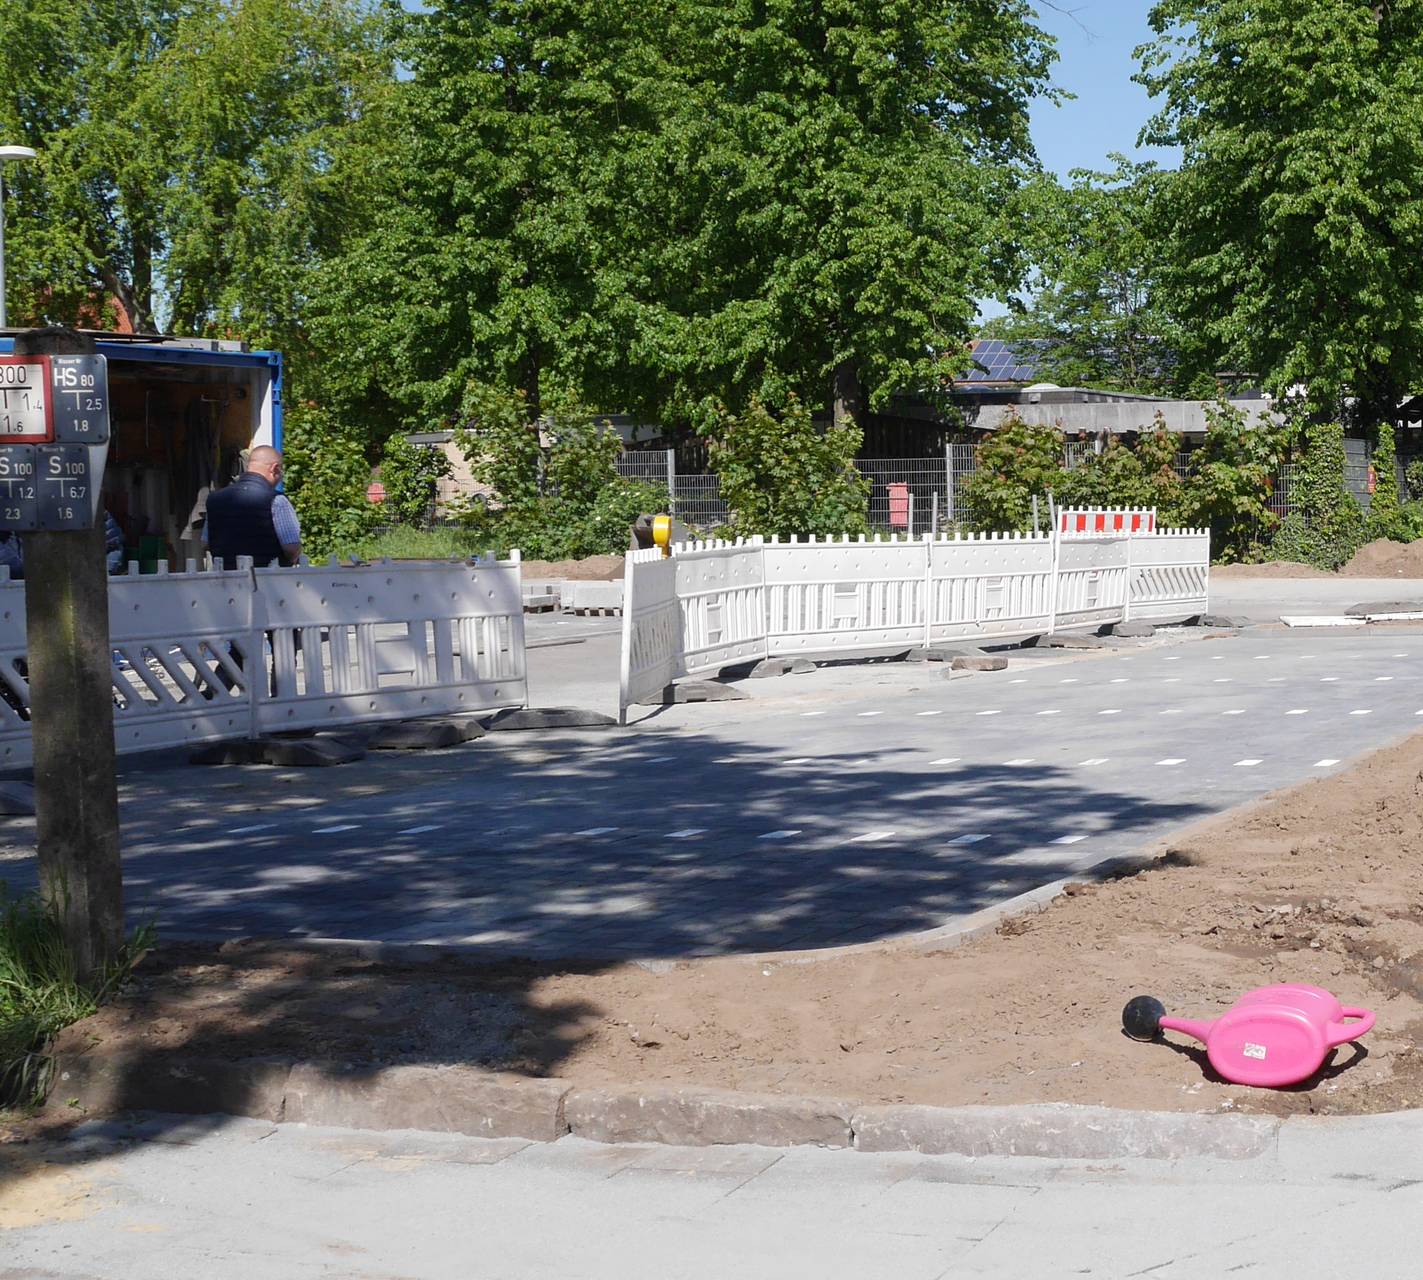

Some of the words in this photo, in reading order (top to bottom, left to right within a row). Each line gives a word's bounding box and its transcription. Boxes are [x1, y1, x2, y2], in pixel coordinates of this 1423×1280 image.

[53, 367, 77, 387] HS
[80, 374, 95, 387] 80
[85, 398, 103, 411] 2.5
[3, 415, 24, 433] 1.6
[73, 419, 89, 432] 1.8
[14, 462, 33, 475] 100
[49, 455, 62, 474] S
[65, 462, 85, 475] 100
[19, 486, 35, 499] 1.2
[69, 486, 87, 498] 6.7
[5, 507, 21, 520] 2.3
[57, 507, 73, 520] 1.6
